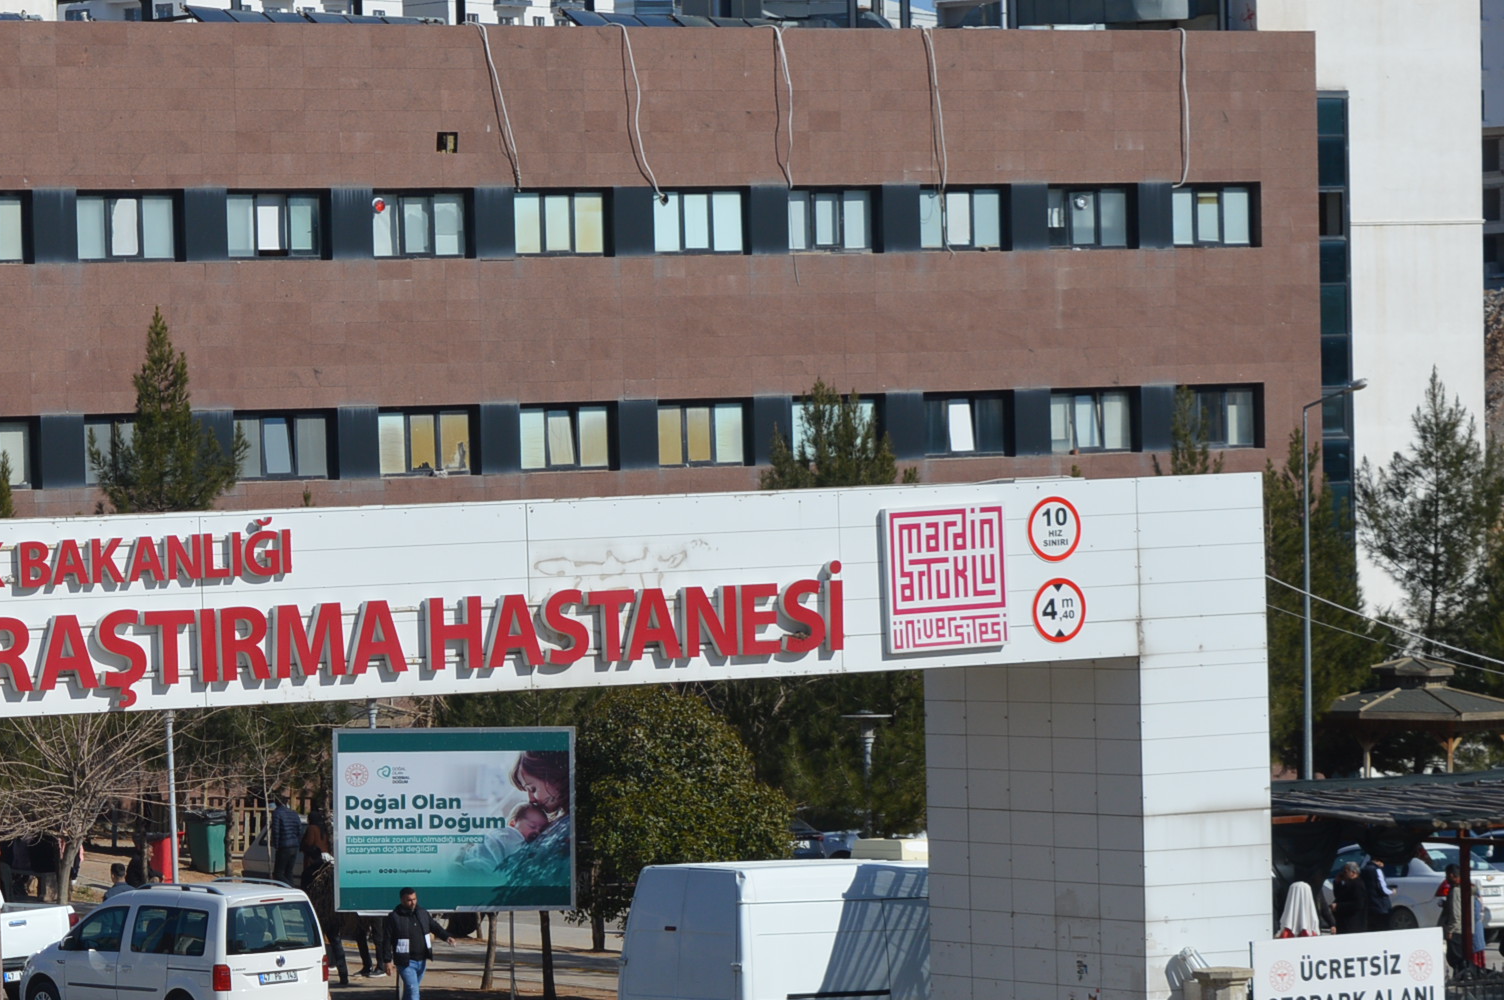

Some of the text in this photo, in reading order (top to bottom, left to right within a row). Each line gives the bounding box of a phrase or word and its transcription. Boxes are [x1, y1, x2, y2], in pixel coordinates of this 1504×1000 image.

[1042, 507, 1067, 527] 10
[1043, 538, 1069, 547] SINIRI
[1048, 530, 1063, 538] HIZ
[20, 516, 293, 588] BAKANLIĞI
[427, 560, 845, 676] HASTANESİ
[1042, 597, 1074, 620] 4 m
[345, 794, 461, 813] Doğal Olan
[345, 813, 505, 832] Normal Doğum
[392, 835, 421, 843] zorunlu
[1299, 949, 1402, 982] ÜCRETSİZ
